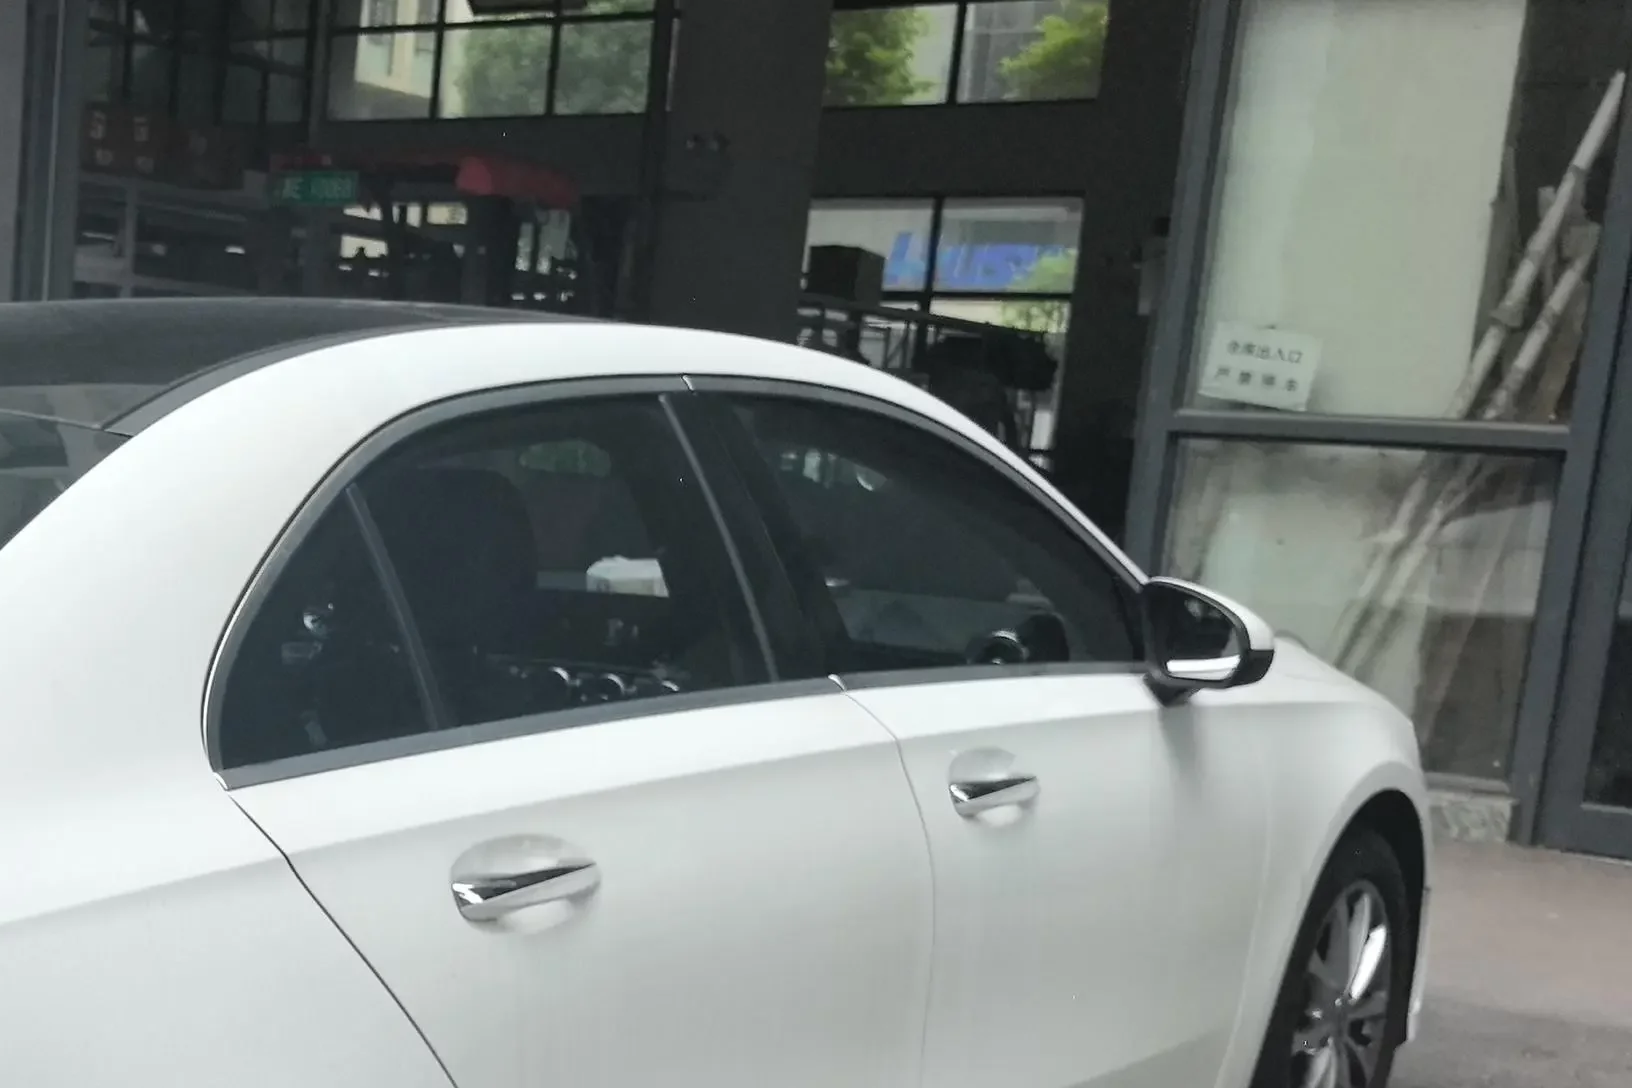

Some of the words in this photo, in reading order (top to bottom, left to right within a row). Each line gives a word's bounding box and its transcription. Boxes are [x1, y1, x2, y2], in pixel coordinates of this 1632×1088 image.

[1226, 339, 1304, 364] 仓库出入口
